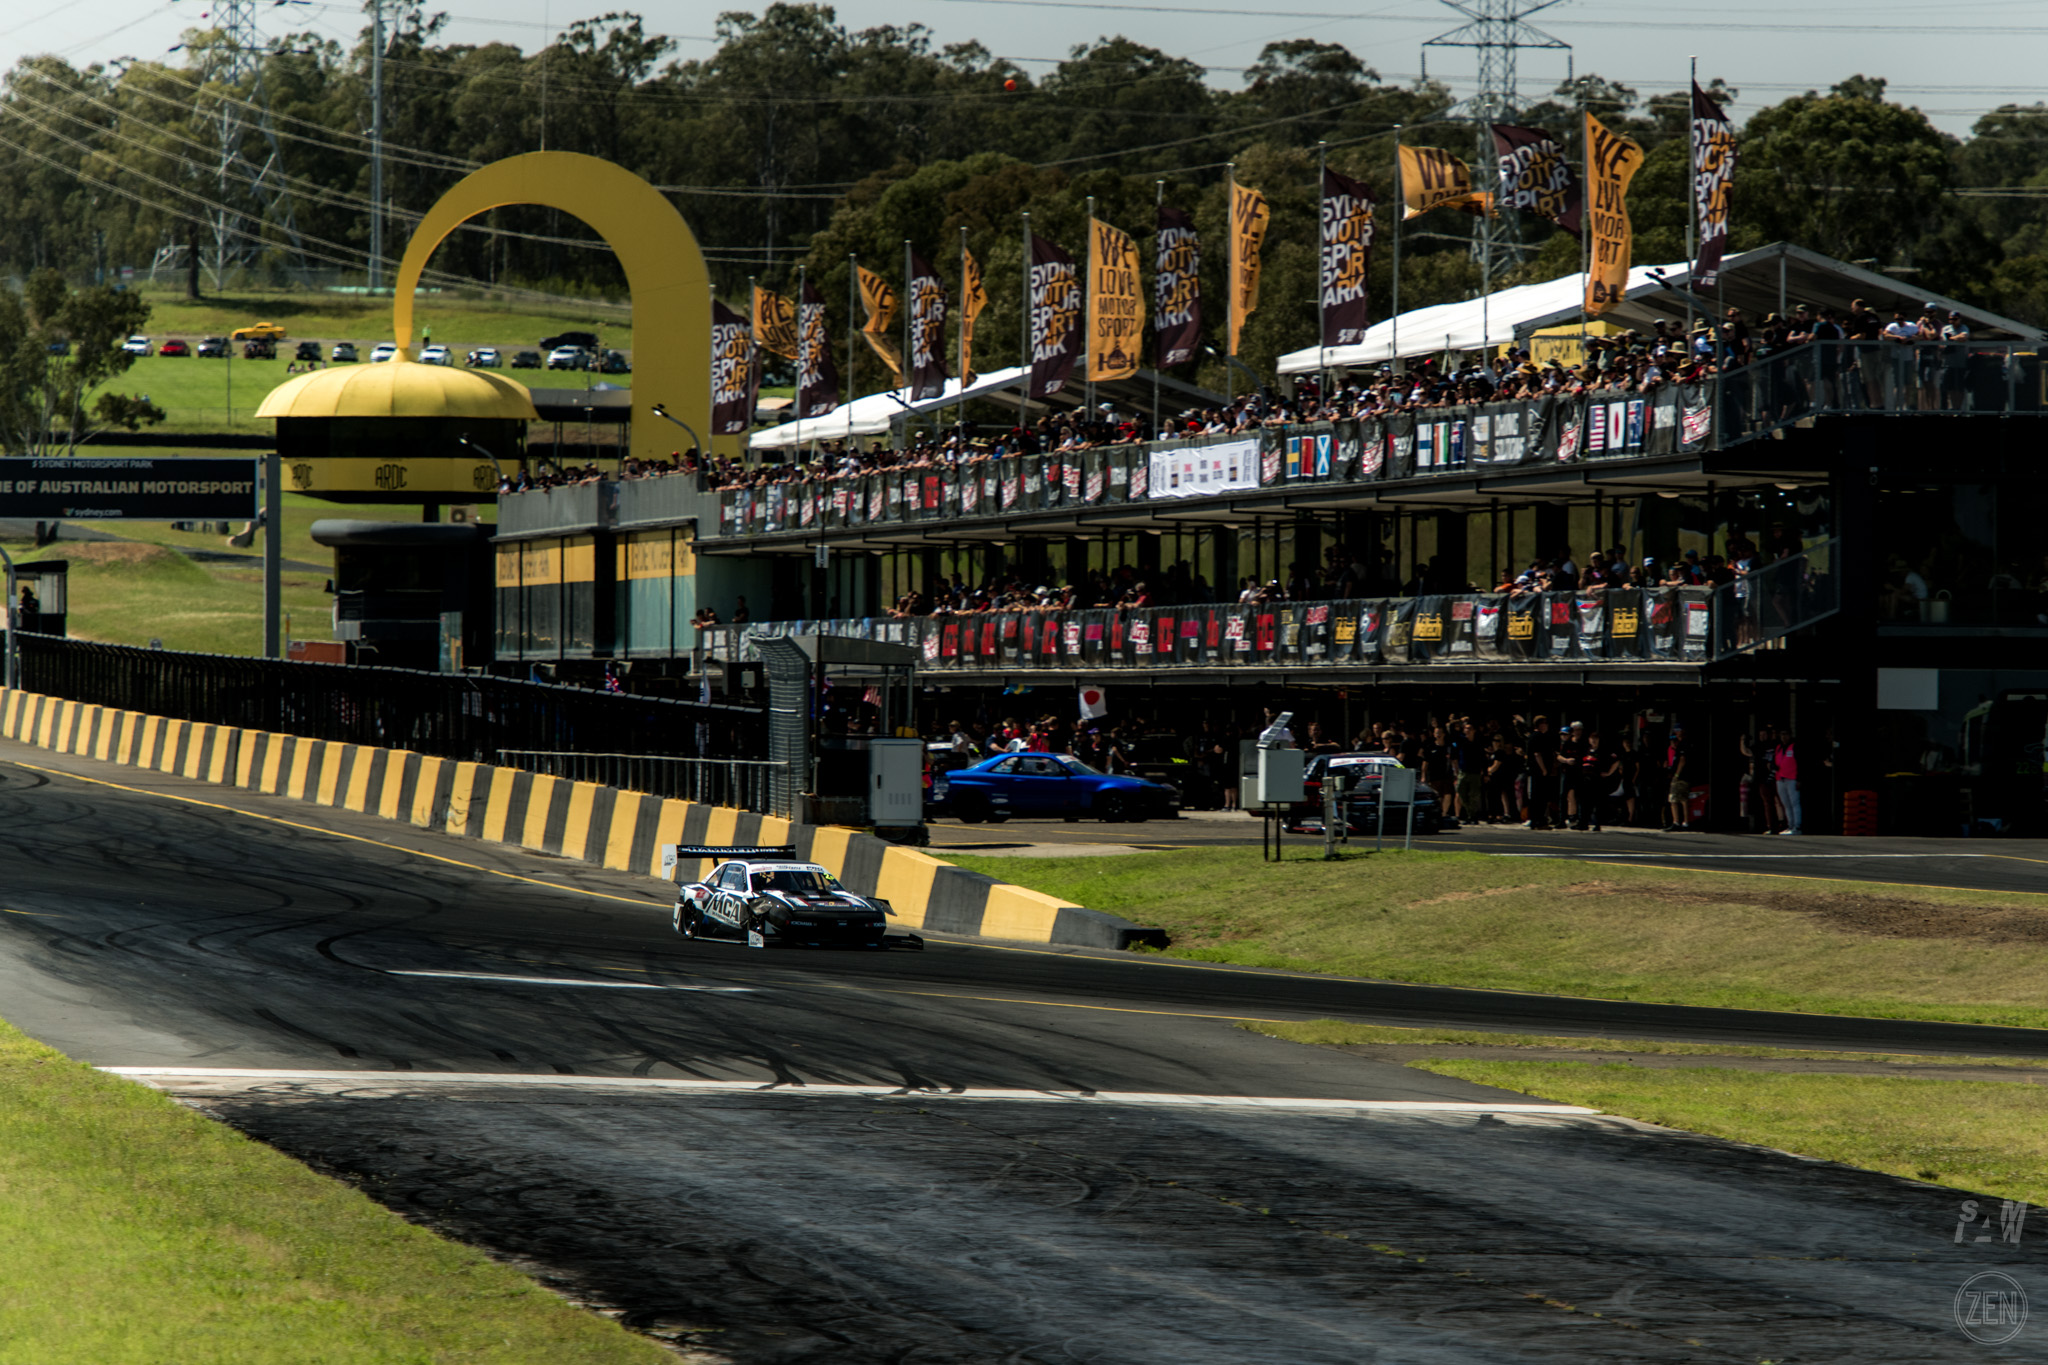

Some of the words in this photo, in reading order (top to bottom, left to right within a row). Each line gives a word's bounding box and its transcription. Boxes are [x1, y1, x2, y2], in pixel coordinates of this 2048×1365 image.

[1097, 224, 1136, 268] WE
[1099, 269, 1137, 297] LOVE
[1098, 298, 1138, 317] MOTOR
[1098, 317, 1138, 338] SPORT
[40, 460, 71, 468] SYDNEY
[74, 460, 128, 468] MOTORSPORT
[130, 460, 153, 468] PARK
[16, 481, 36, 494] OF
[40, 481, 139, 494] AUSTRALIAN
[142, 481, 253, 494] MOTORSPORT
[376, 464, 408, 490] ARDC
[74, 507, 122, 517] sydney.com
[704, 891, 741, 922] MCA
